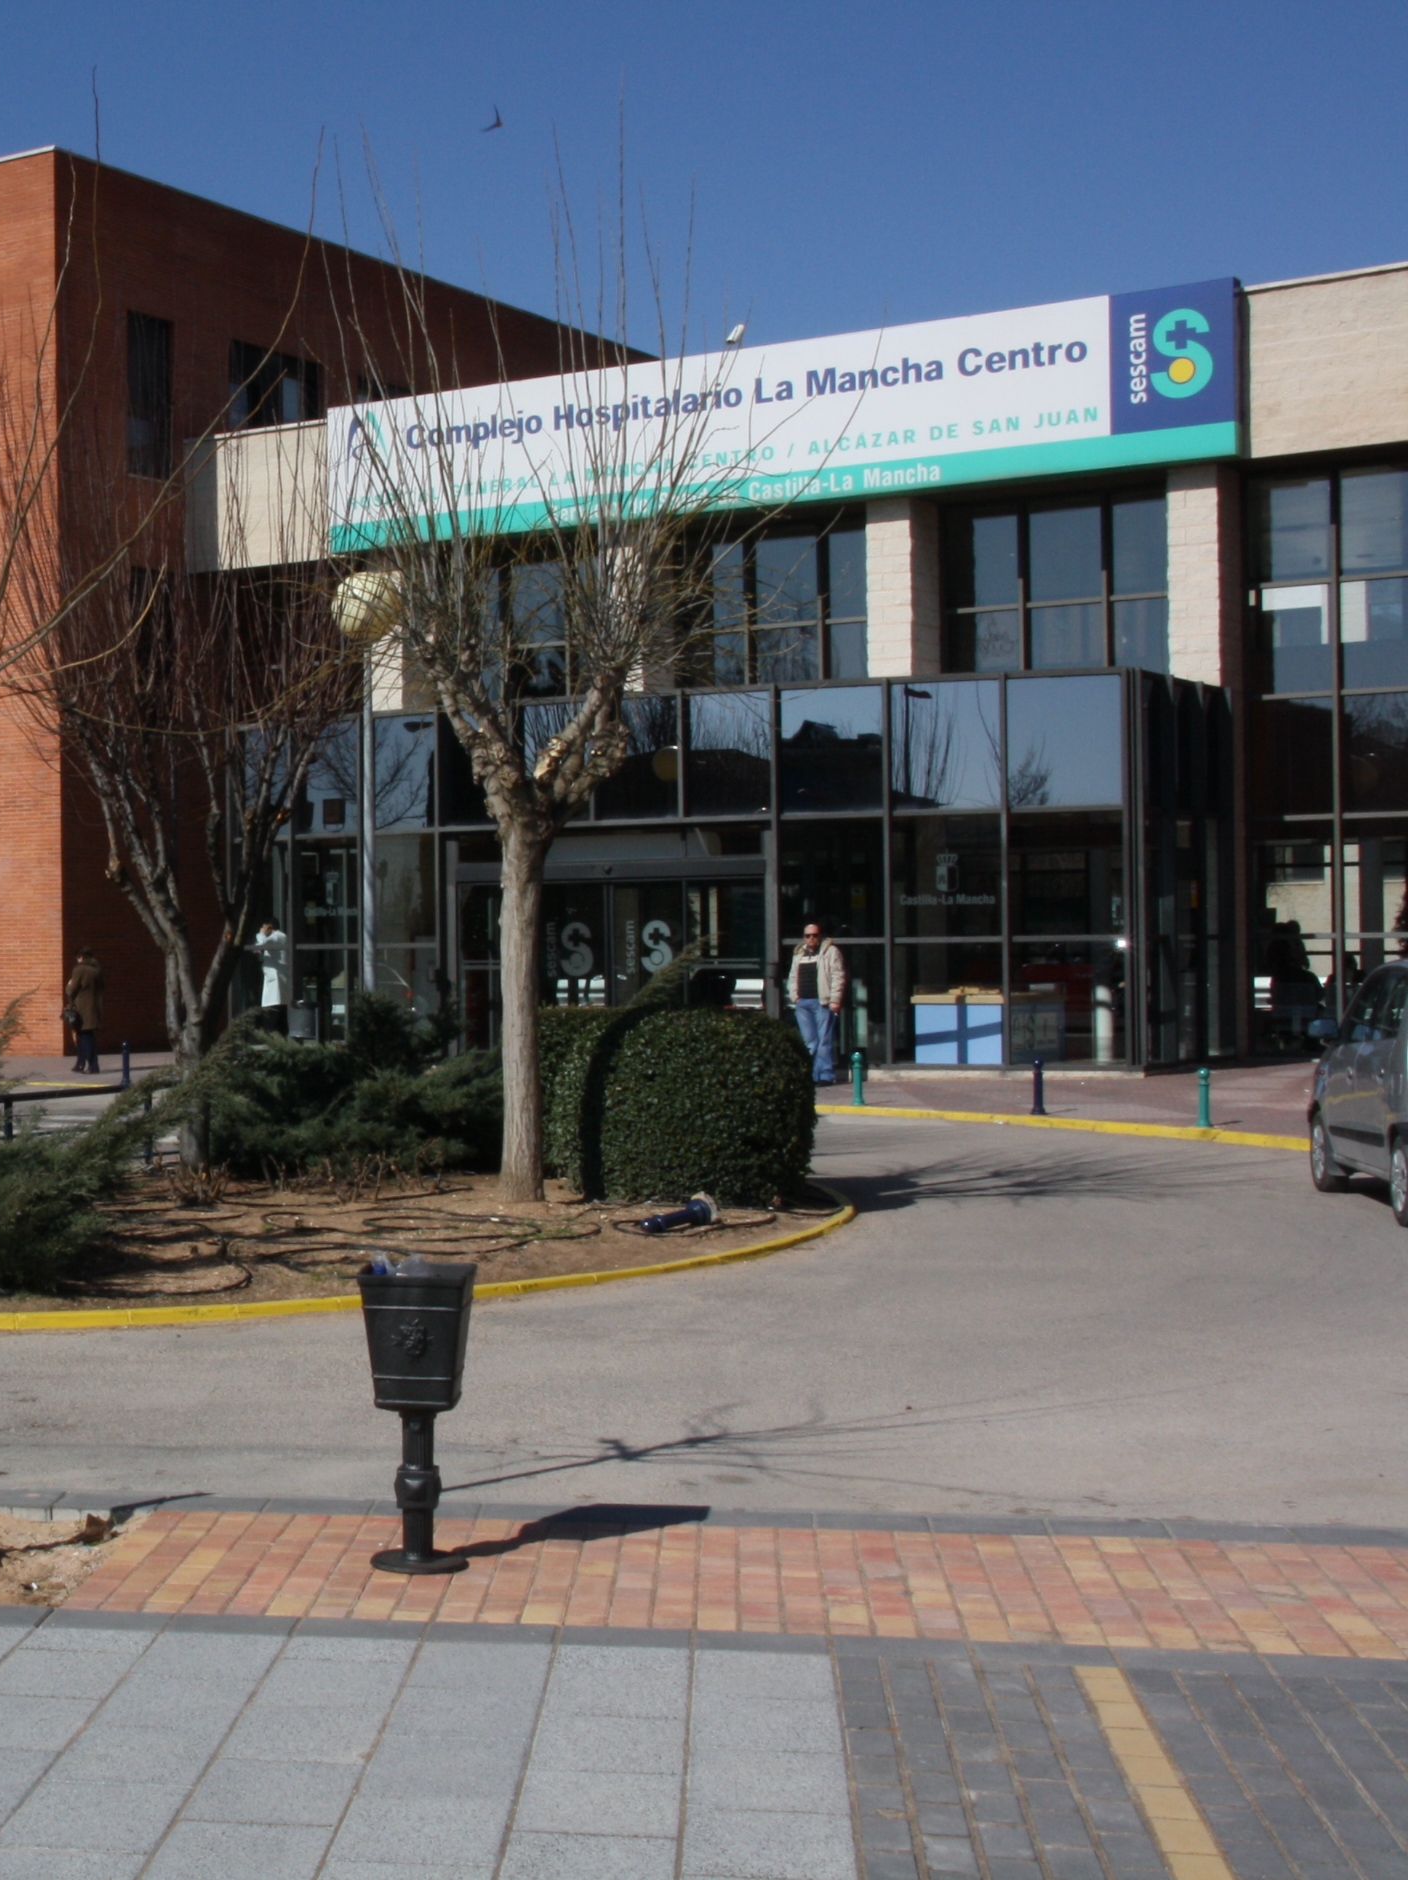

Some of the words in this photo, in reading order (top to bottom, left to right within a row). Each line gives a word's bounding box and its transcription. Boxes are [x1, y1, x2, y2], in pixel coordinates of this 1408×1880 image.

[1129, 313, 1146, 404] sescam
[406, 411, 542, 449] Complejo
[554, 383, 742, 432] Hospitalario
[755, 378, 794, 404] La
[806, 357, 943, 397] Mancha
[957, 340, 1087, 377] Centro
[454, 476, 539, 497] GENERAL
[551, 471, 574, 485] LA
[689, 446, 774, 469] CENTRO
[787, 443, 794, 458] /
[808, 429, 916, 455] ALCÁZAR
[930, 424, 958, 441] DE
[972, 417, 1020, 436] SAN
[1033, 407, 1098, 429] JUAN
[749, 473, 854, 501] Castilla-La
[863, 464, 941, 488] Mancha
[899, 894, 954, 905] Castilla-La
[956, 893, 996, 905] Mancha
[546, 921, 558, 977] sescam
[625, 920, 637, 974] sescam
